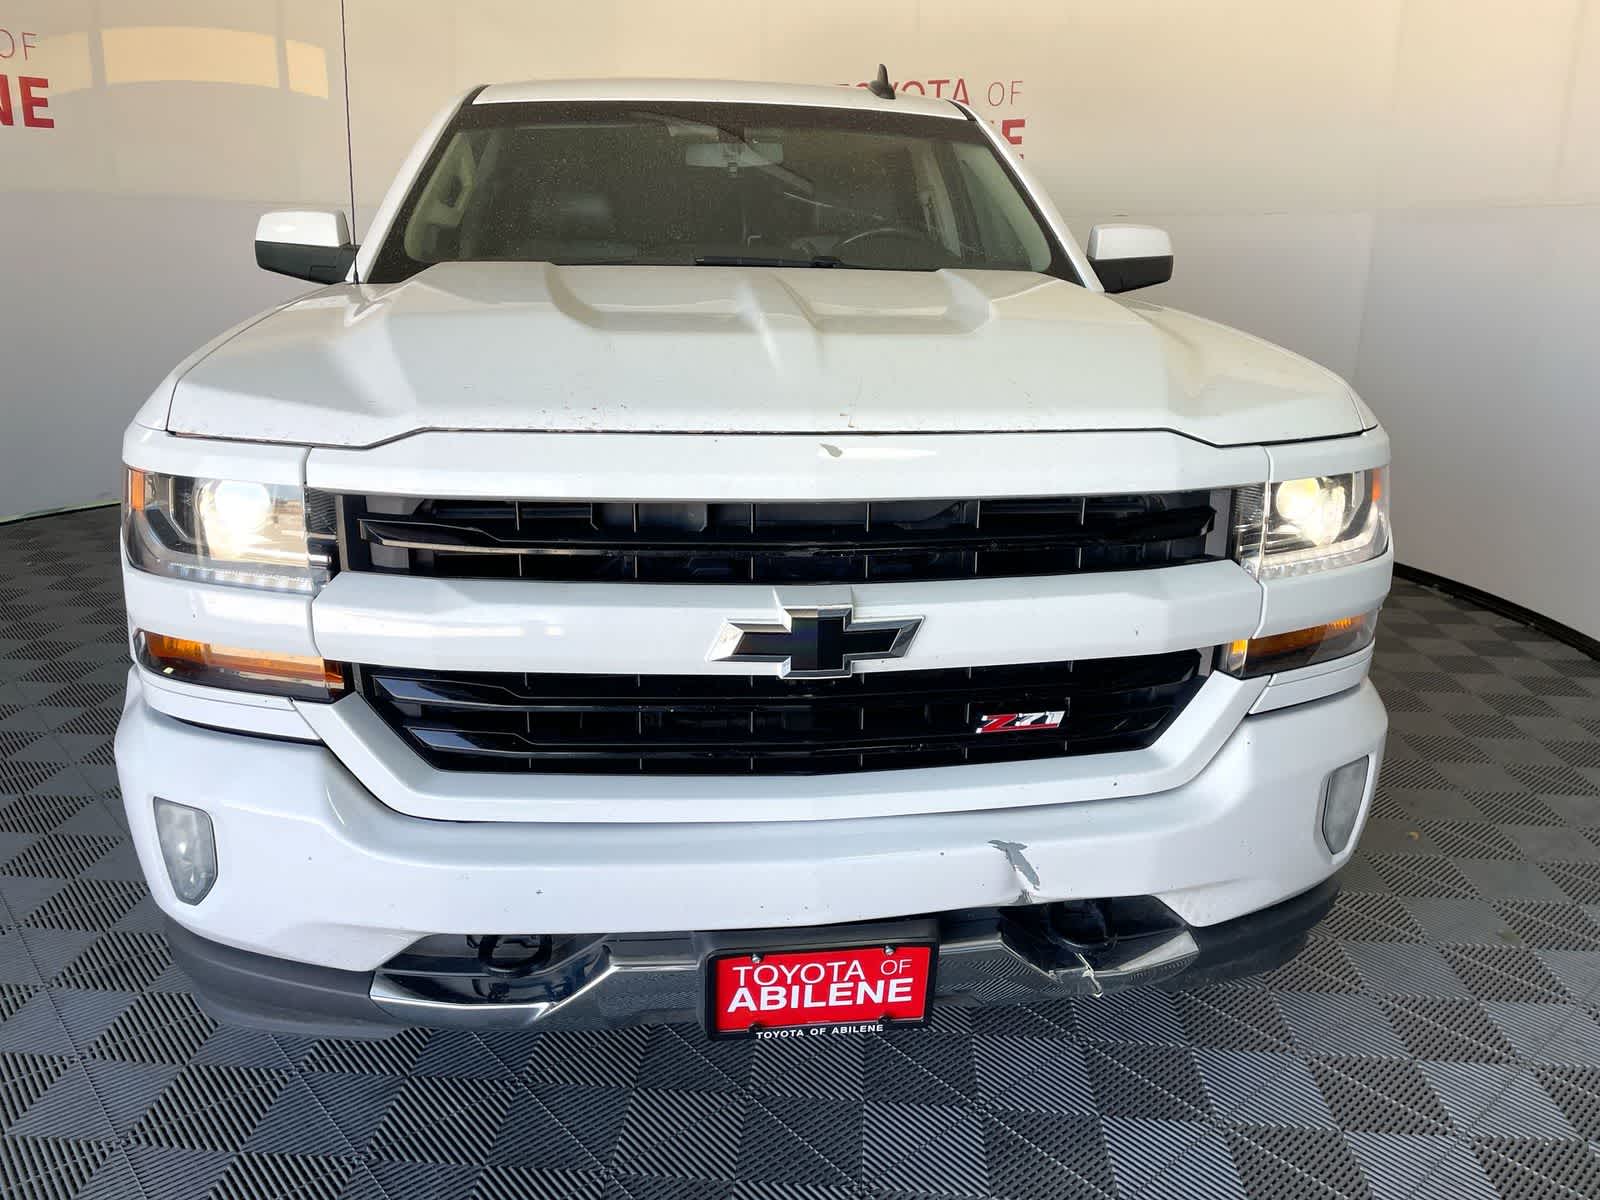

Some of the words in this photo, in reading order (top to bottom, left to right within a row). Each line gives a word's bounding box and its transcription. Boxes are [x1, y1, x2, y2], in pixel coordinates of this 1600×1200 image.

[987, 80, 1024, 107] OF
[975, 710, 1066, 734] Z71
[732, 959, 865, 987] TOYOTA
[880, 958, 912, 976] OF
[727, 977, 914, 1013] ABILENE
[755, 1028, 805, 1040] TOYOTA
[809, 1026, 827, 1037] OF
[831, 1023, 884, 1035] ABILENE
